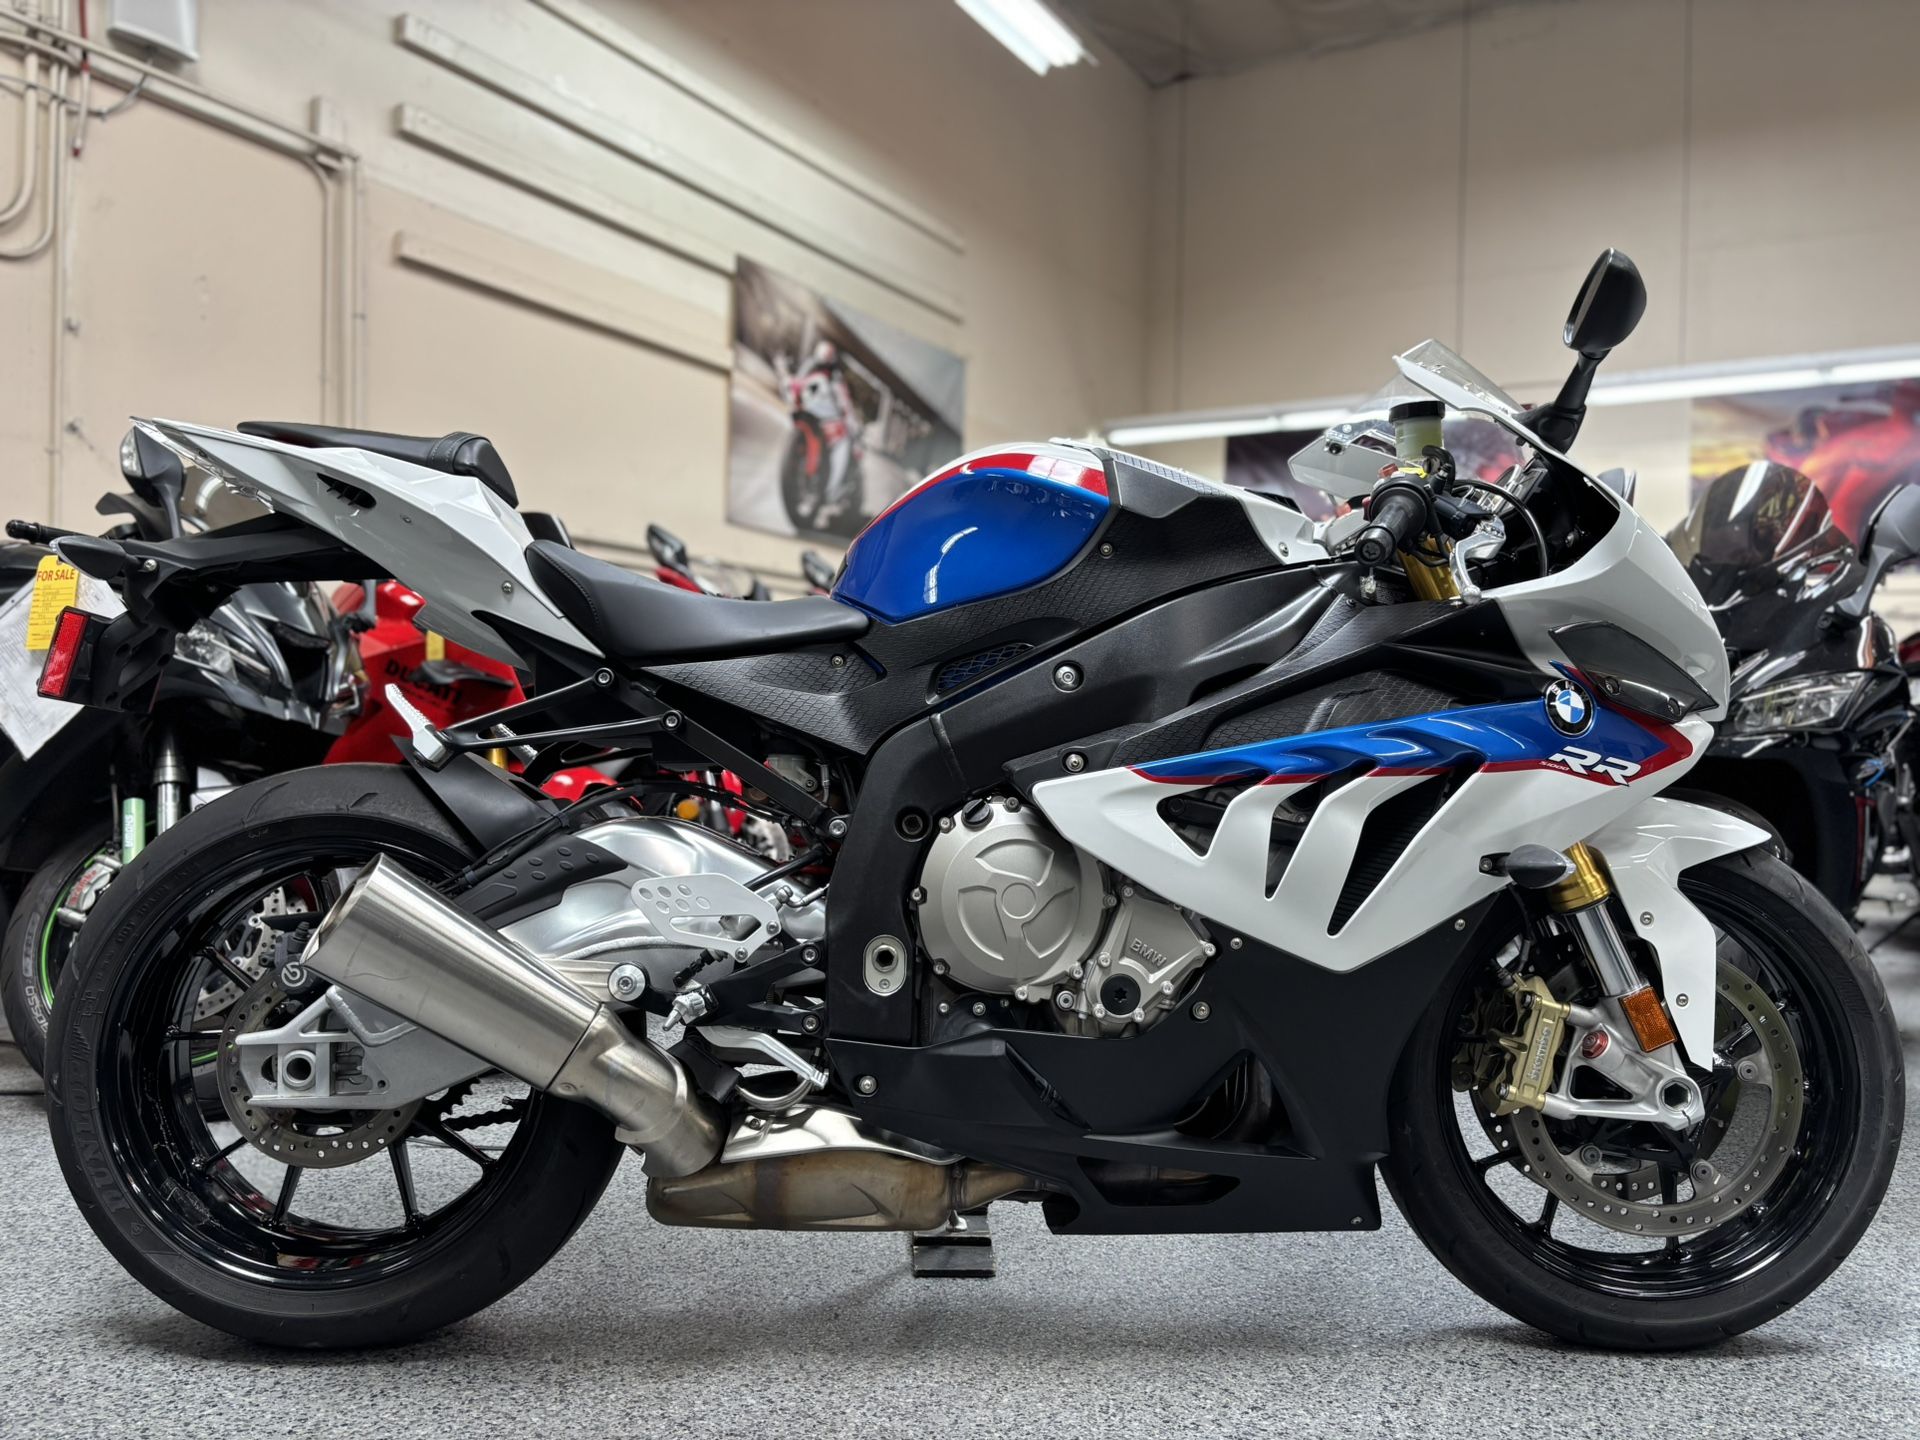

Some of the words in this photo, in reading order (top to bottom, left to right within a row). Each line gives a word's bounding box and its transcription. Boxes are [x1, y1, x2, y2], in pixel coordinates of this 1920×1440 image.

[36, 569, 54, 582] FOR
[54, 568, 75, 581] SALE
[1548, 746, 1642, 786] RR
[1130, 938, 1167, 967] BMW
[1526, 1026, 1552, 1081] brembo
